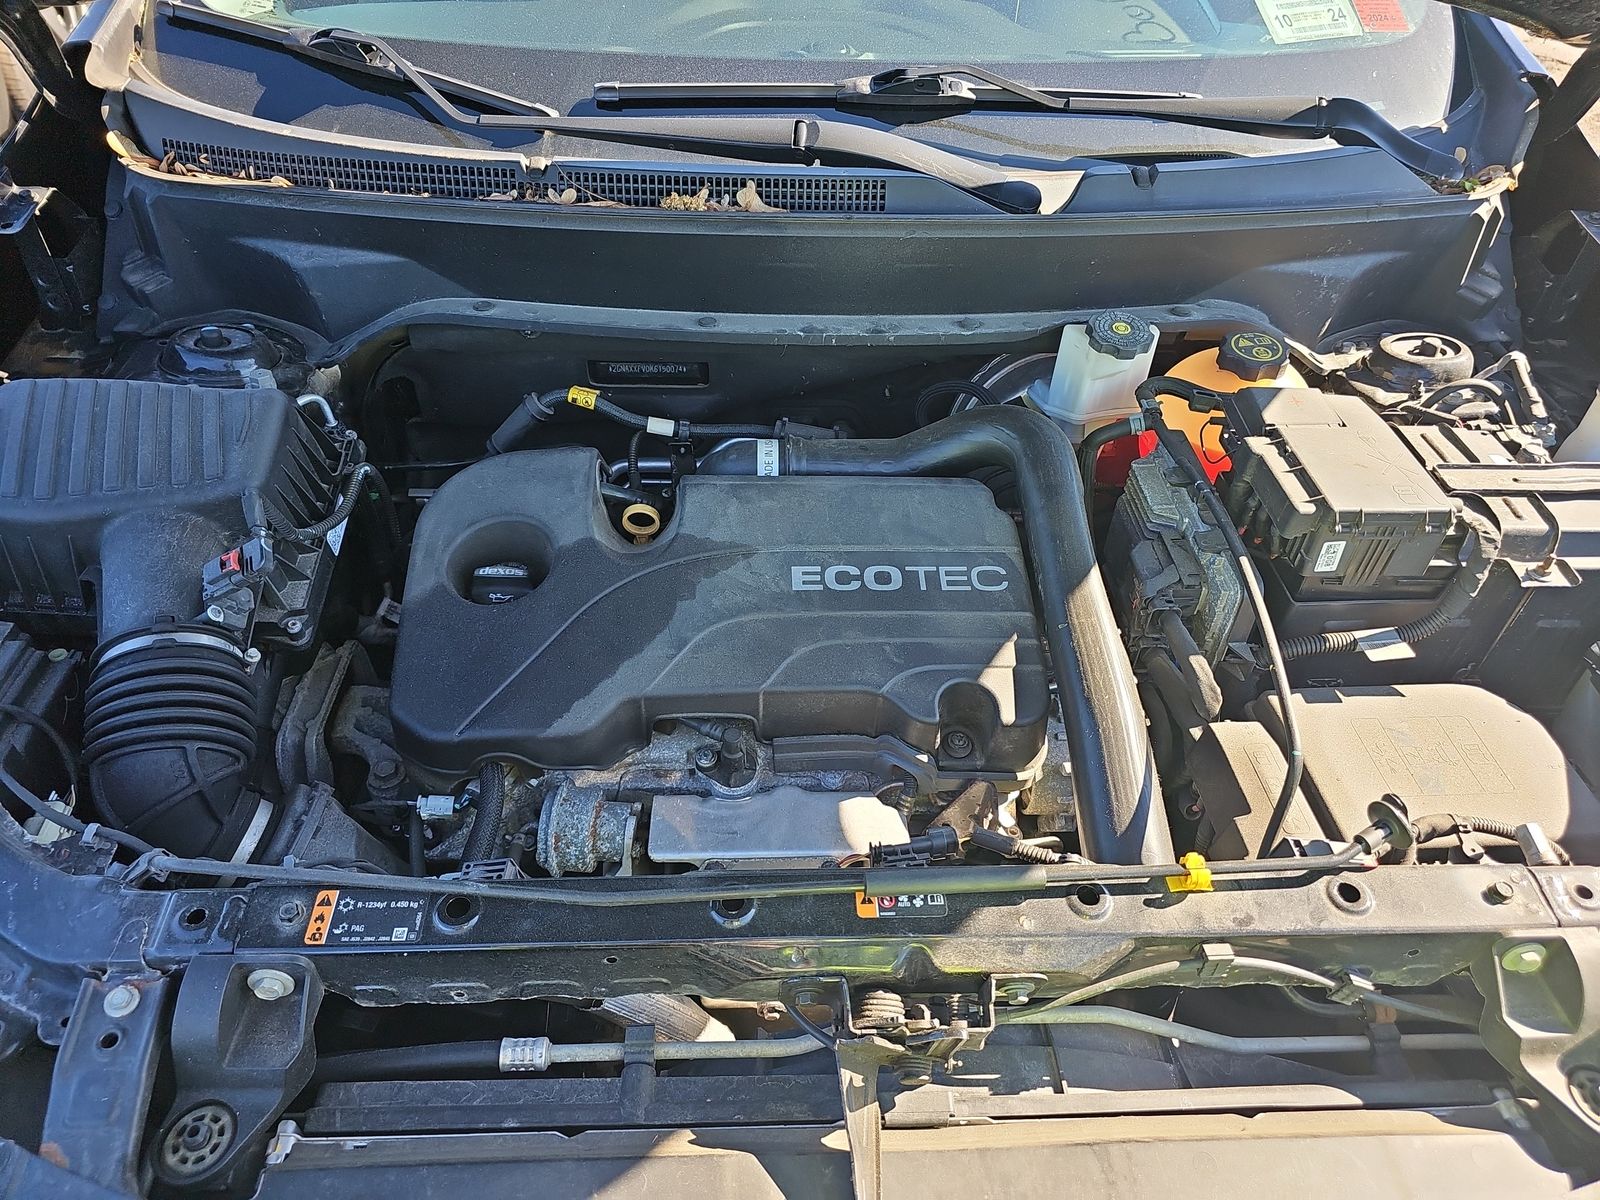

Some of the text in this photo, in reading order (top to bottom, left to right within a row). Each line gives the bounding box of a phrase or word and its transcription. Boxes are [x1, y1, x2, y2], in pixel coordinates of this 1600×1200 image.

[1275, 14, 1293, 29] 10
[1327, 7, 1347, 22] 24
[791, 565, 1009, 591] ECOTEC
[357, 901, 387, 909] R-1234yf
[410, 901, 418, 909] kg
